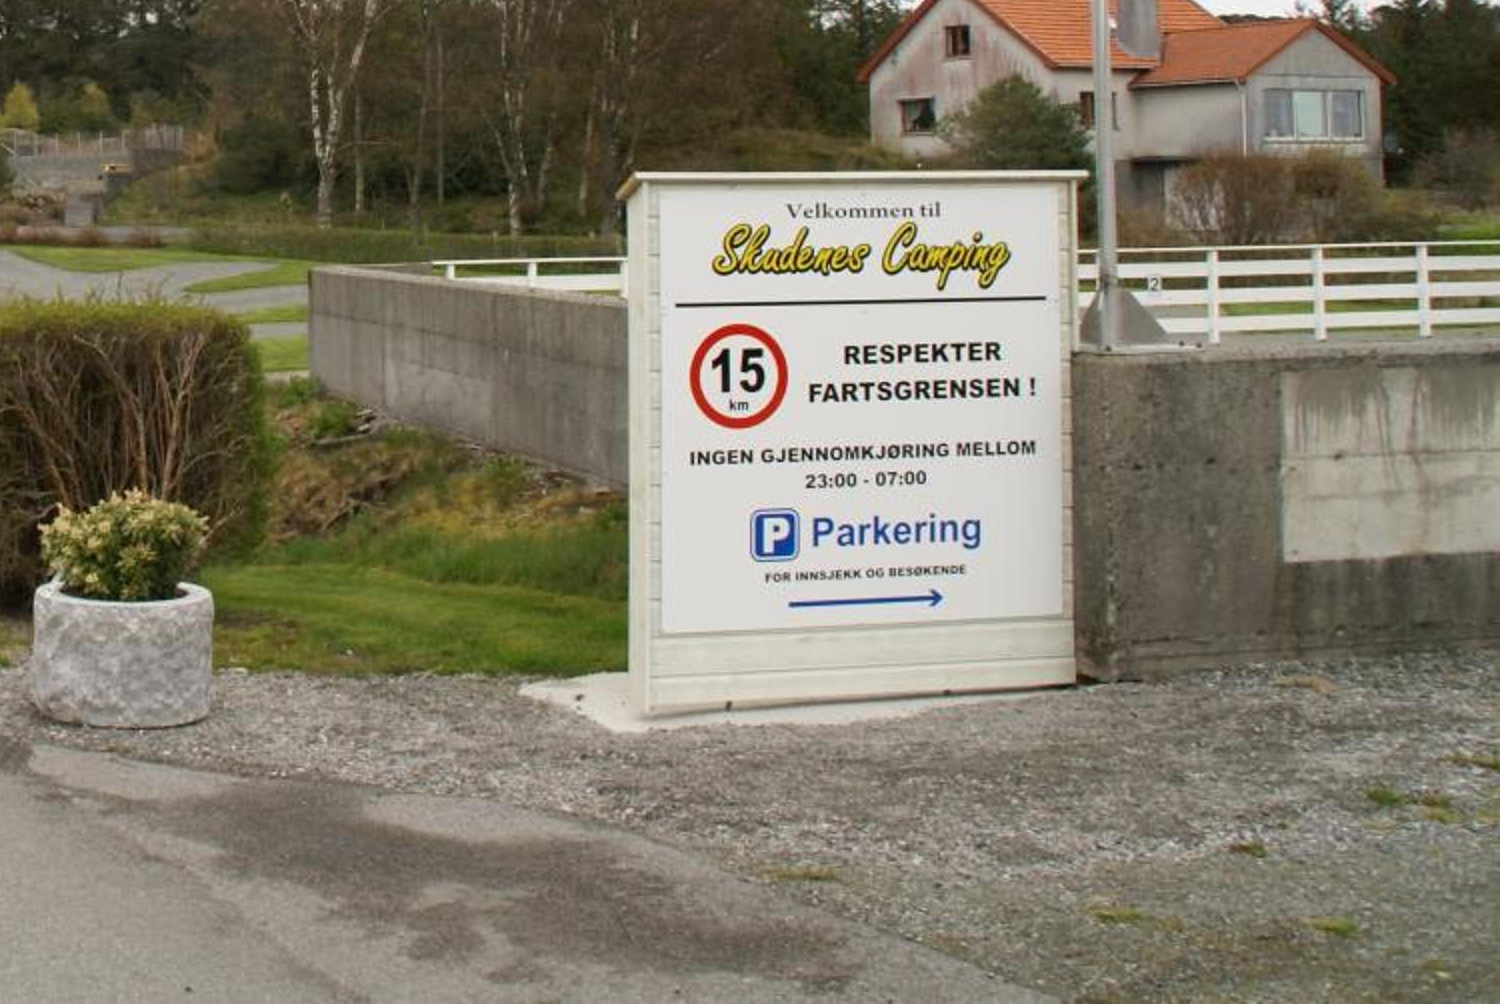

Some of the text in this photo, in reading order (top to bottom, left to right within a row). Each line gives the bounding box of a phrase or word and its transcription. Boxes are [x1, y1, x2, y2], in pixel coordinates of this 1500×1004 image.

[786, 201, 941, 219] Velkommen til
[711, 221, 1011, 291] Skudenes Camping
[844, 341, 1001, 365] RESPEKTER
[710, 347, 766, 393] 15
[808, 377, 1036, 403] FARTSGRENSEN !
[728, 399, 750, 412] km
[689, 439, 1037, 467] INGEN GJENNOMKJØRING MELLOM
[805, 472, 857, 490] 23:00
[875, 469, 927, 487] 07:00
[763, 513, 981, 554] P Parkering
[764, 564, 968, 583] FOR INNSJEKK OG BESØKENDE
